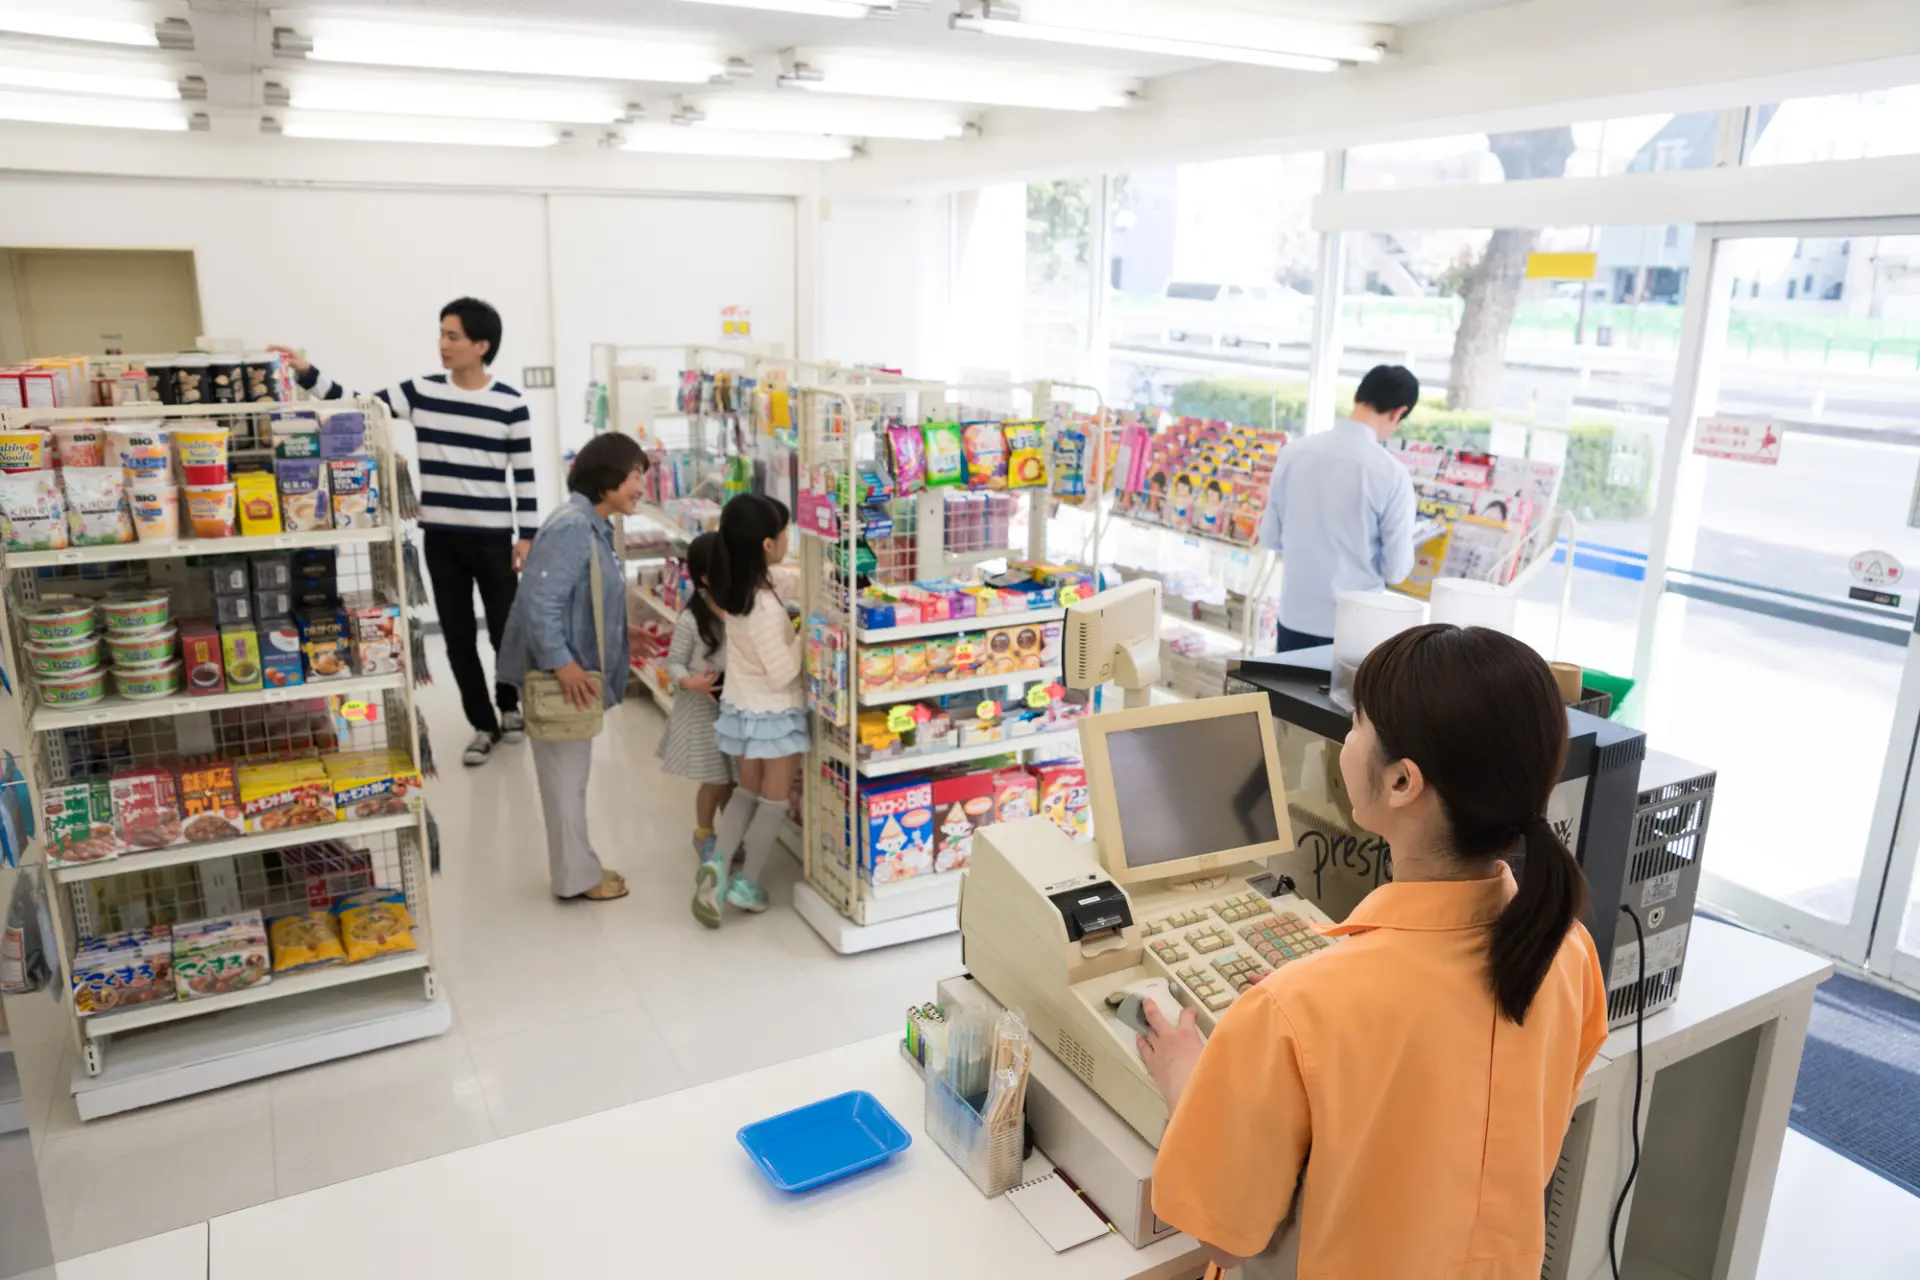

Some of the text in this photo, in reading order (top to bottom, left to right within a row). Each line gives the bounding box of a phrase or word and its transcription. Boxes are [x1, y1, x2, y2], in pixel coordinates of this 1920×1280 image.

[73, 433, 96, 442] BIG
[129, 437, 153, 446] BIG
[135, 494, 158, 502] BIG
[905, 786, 932, 810] BIG
[178, 953, 244, 979] こくまろ
[85, 963, 154, 990] こくまろ
